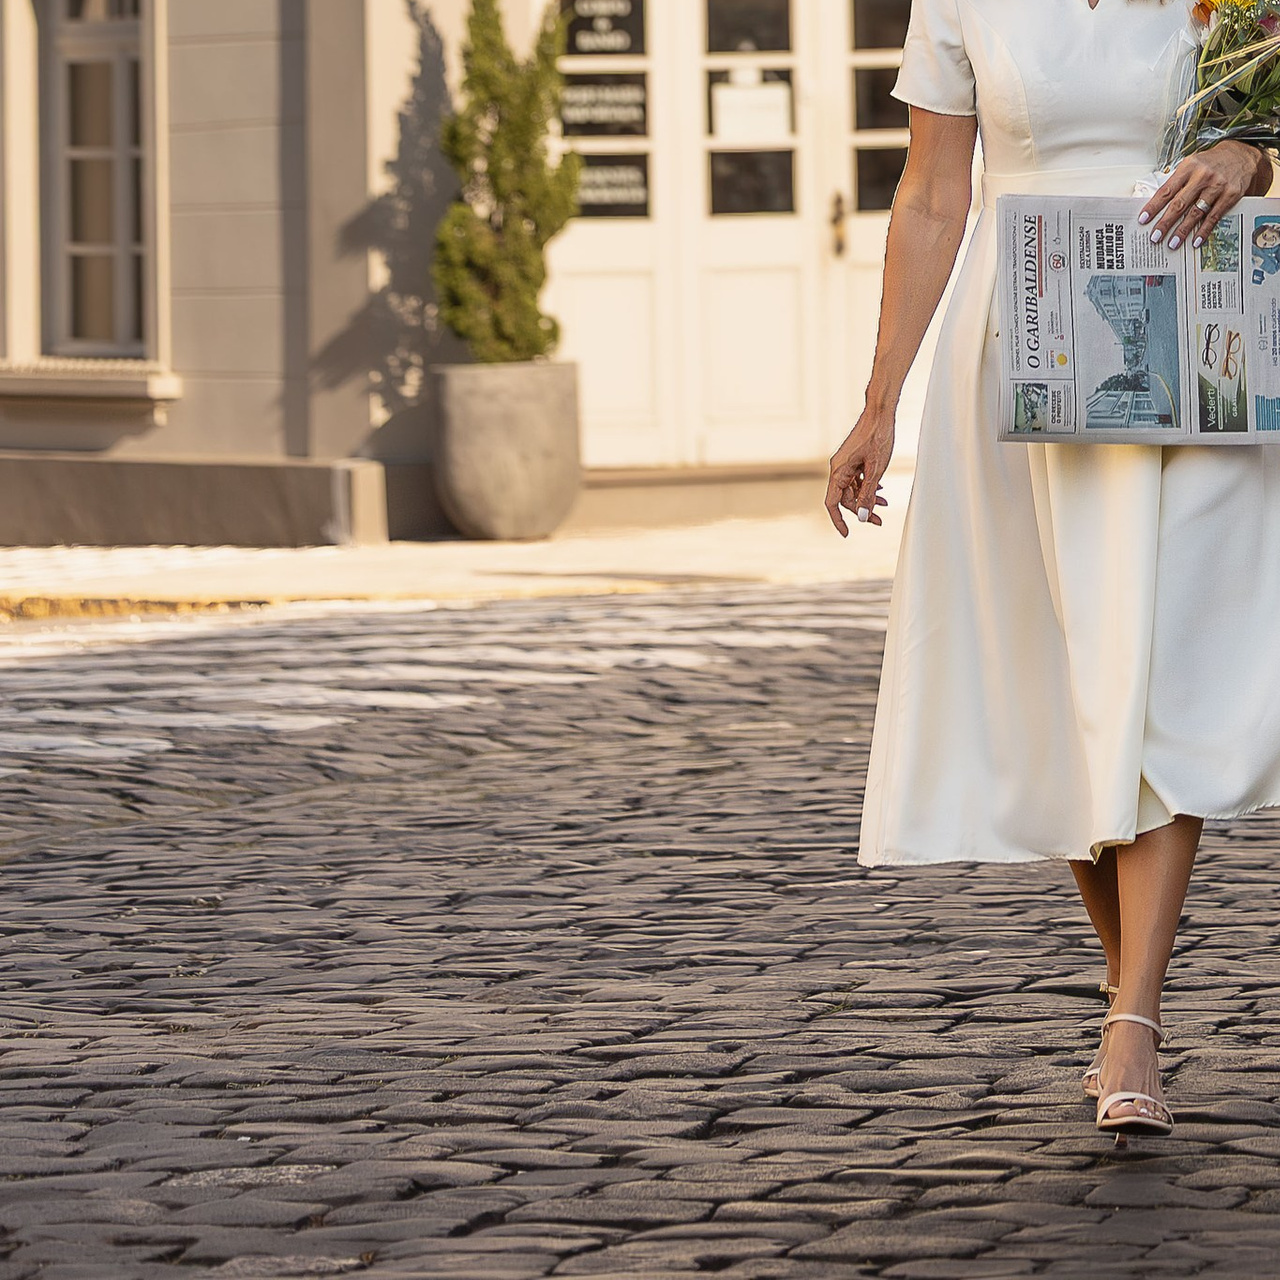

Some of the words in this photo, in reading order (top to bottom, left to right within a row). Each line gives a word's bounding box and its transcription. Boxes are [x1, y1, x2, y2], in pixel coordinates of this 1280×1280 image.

[1105, 223, 1114, 233] DE
[1096, 228, 1105, 269] MUDANÇA
[1115, 224, 1125, 269] CASTILHOS
[1106, 258, 1115, 269] NA
[1023, 214, 1040, 351] GARIBALDENSE
[1026, 355, 1041, 368] O
